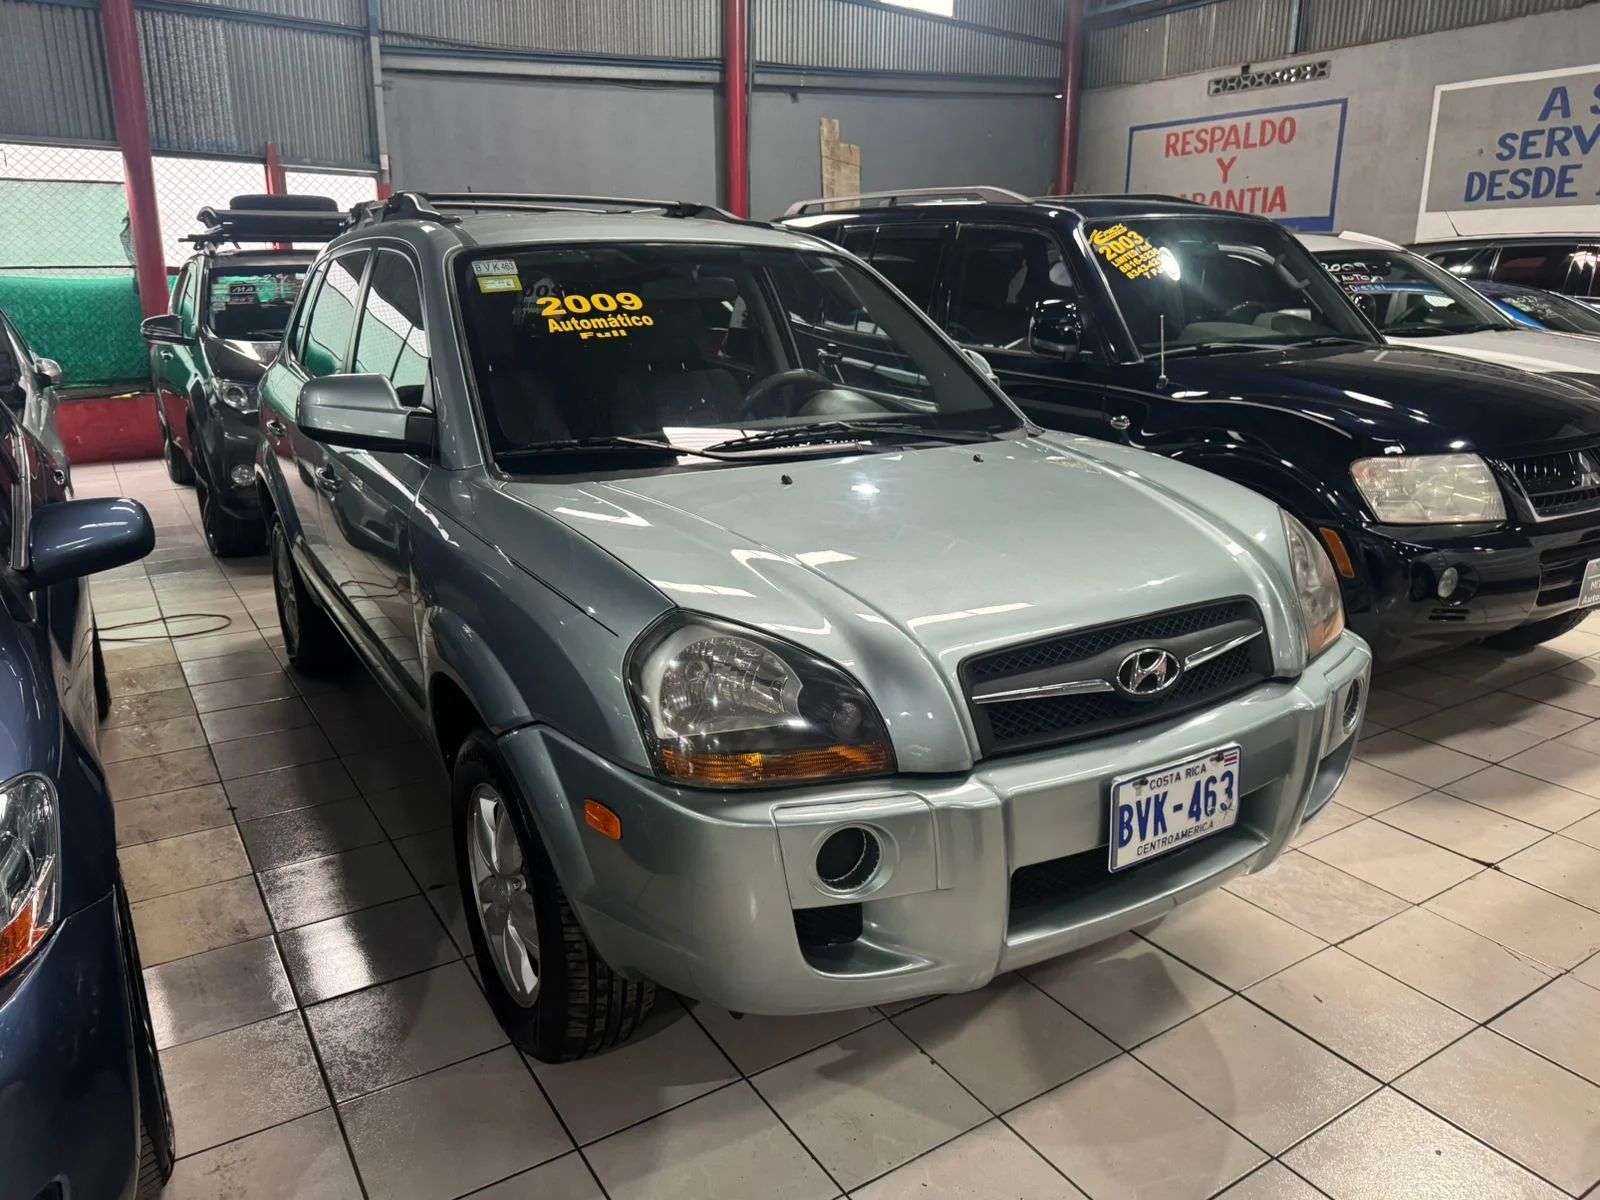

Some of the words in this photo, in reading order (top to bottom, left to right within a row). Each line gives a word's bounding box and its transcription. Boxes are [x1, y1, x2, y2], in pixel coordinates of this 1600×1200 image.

[1537, 86, 1571, 122] A
[1164, 116, 1297, 158] RESPALDO
[1216, 156, 1237, 184] Y
[1464, 163, 1583, 202] DESDE
[1179, 185, 1287, 214] ANTIA
[1098, 230, 1145, 261] 2003
[1320, 261, 1370, 272] 2009
[536, 292, 644, 317] 2009
[548, 313, 654, 334] Automático
[579, 329, 628, 340] Full
[1149, 771, 1182, 791] COSTA
[1185, 763, 1207, 779] RICA
[1118, 770, 1235, 849] BVK-463
[1136, 820, 1214, 857] CENTROAMERICA
